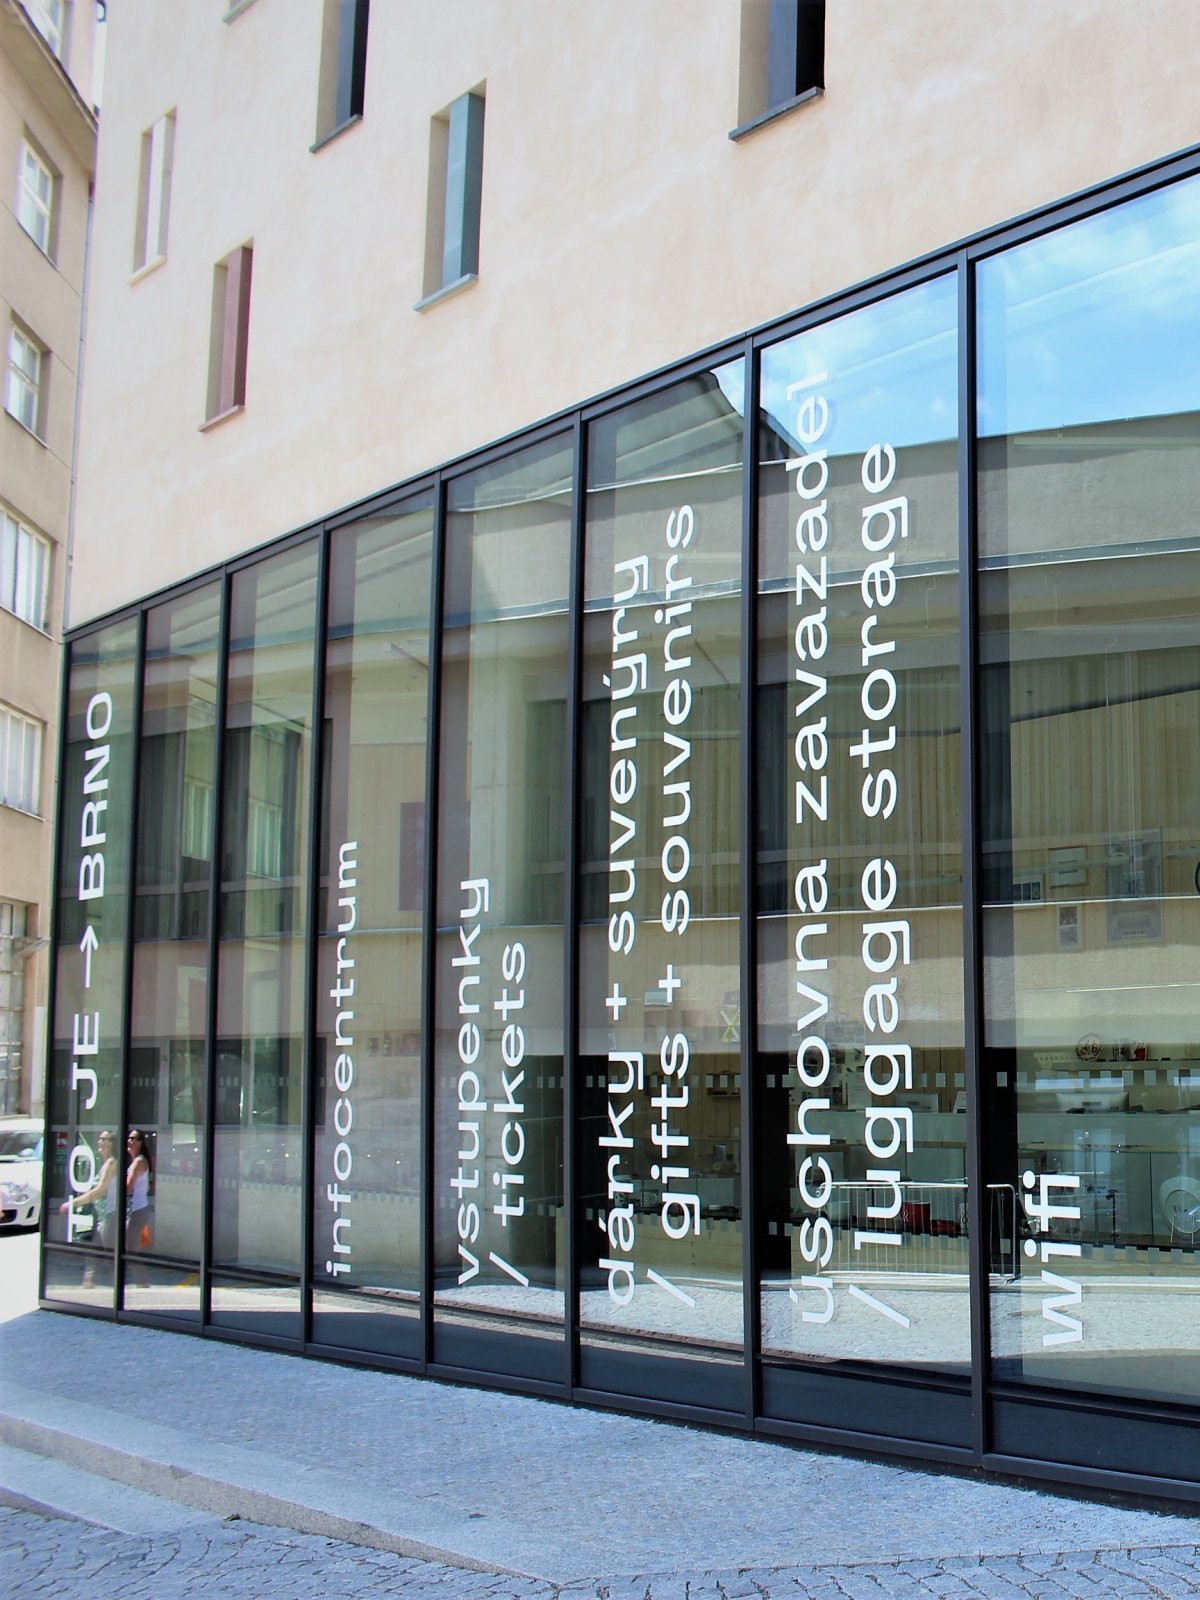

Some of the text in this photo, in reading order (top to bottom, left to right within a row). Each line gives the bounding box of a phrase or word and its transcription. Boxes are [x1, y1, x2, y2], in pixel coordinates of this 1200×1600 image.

[604, 553, 649, 956] suvenýry
[654, 502, 695, 936] souvenirs
[849, 442, 909, 820] storage
[65, 692, 113, 1243] TO JE BRNO
[785, 369, 835, 1324] úschovna zavazadel
[326, 841, 358, 1278] infocentrum
[450, 878, 490, 1286] vstupenky
[493, 942, 526, 1227] tickets
[598, 1051, 645, 1306] dárky
[650, 1032, 701, 1240] gifts
[854, 857, 914, 1250] luggage
[1022, 1170, 1083, 1347] wifi
